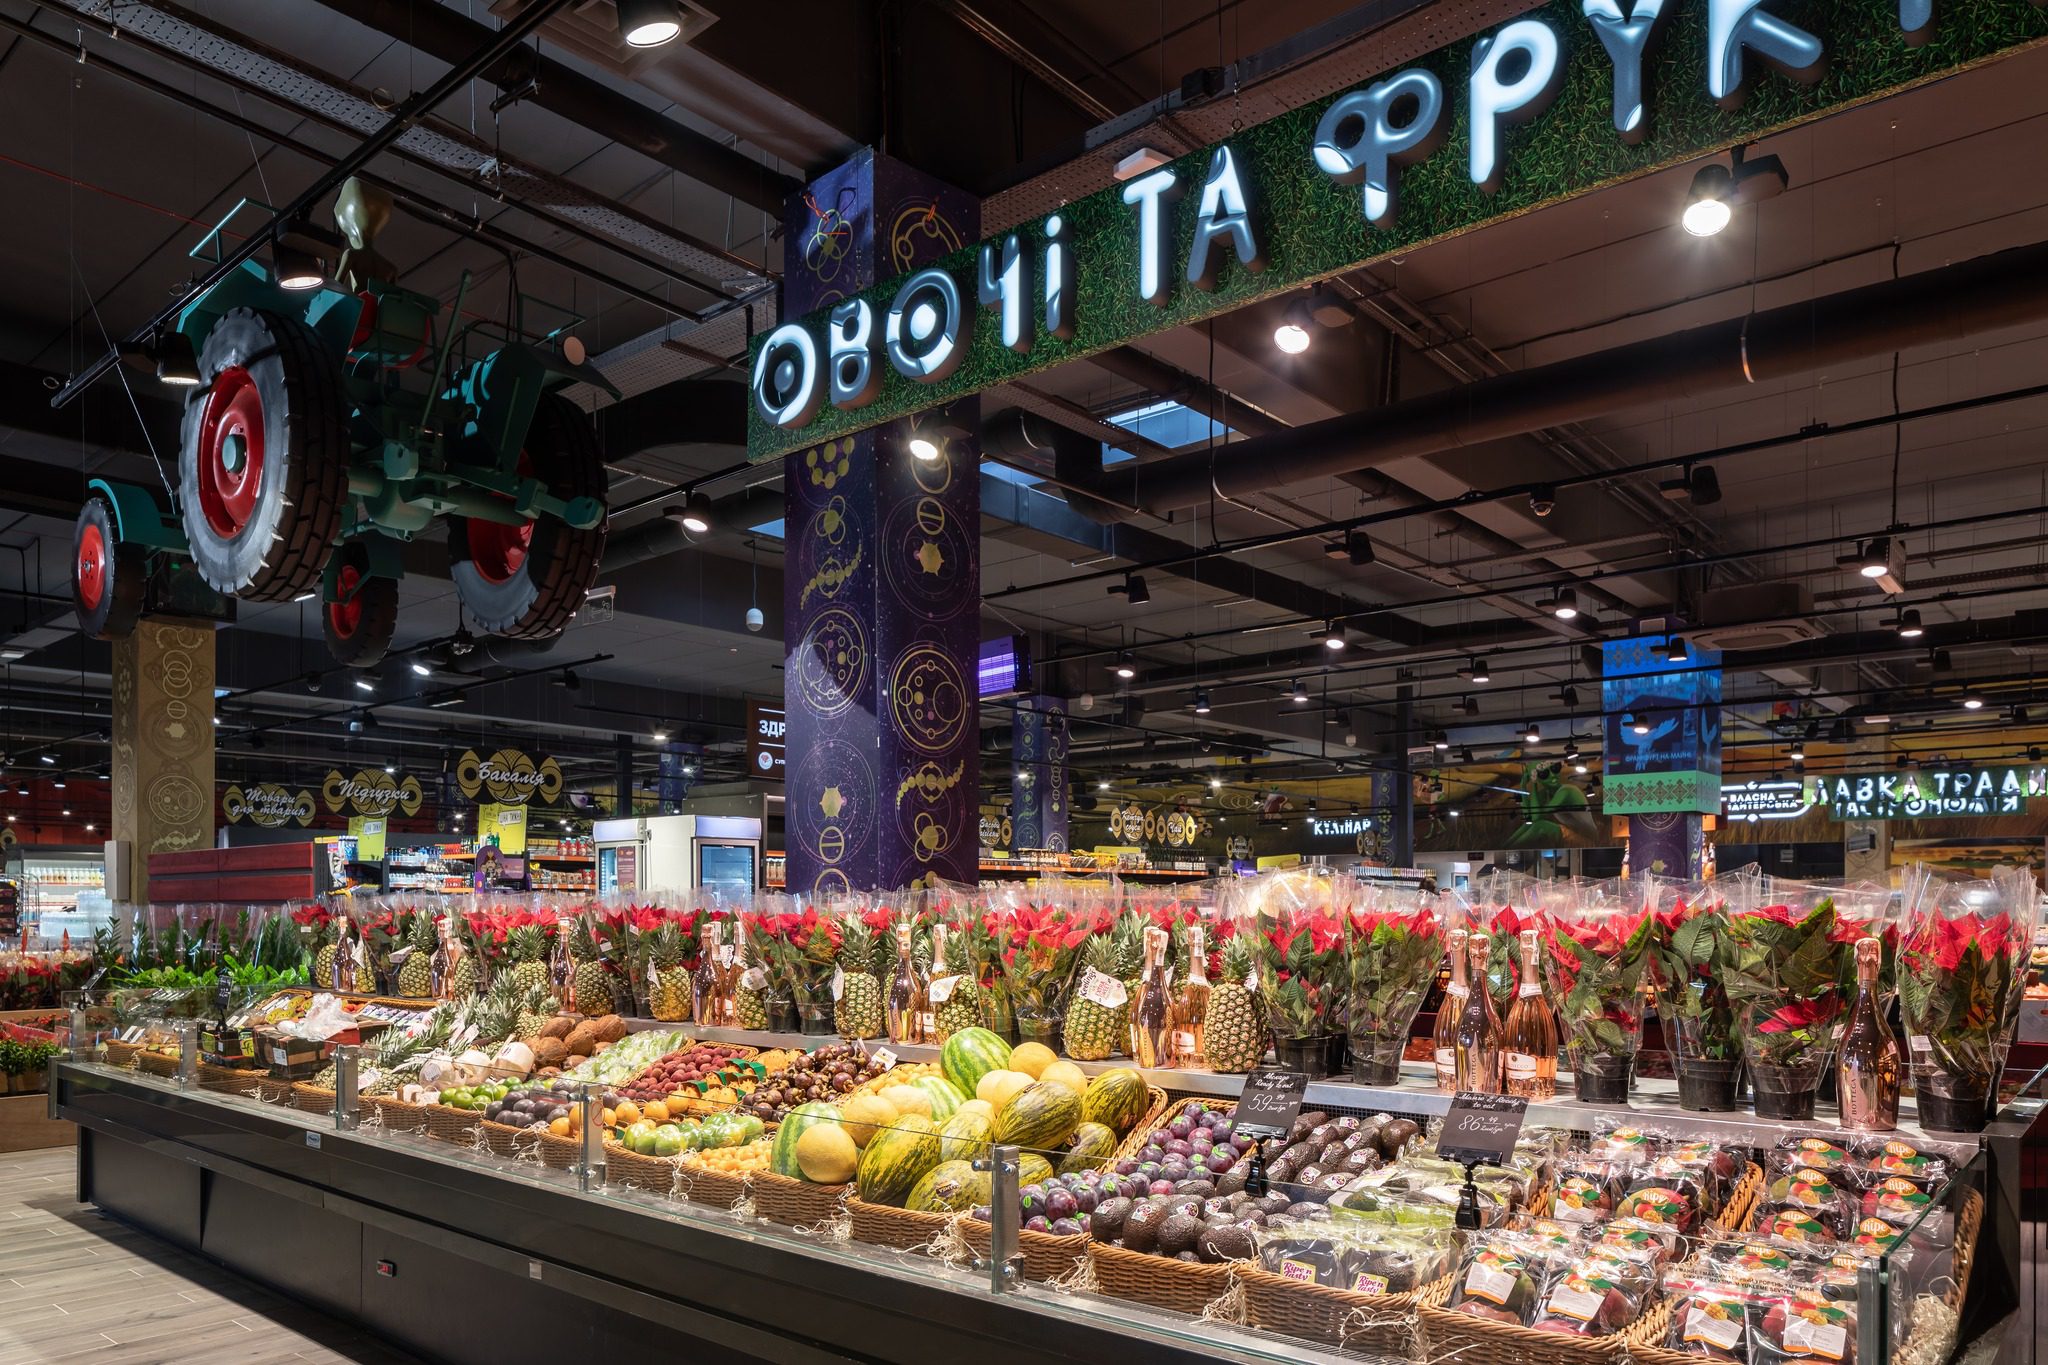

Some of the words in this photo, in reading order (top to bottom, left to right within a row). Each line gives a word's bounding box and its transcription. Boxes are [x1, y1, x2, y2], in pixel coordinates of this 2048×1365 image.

[1123, 145, 1256, 301] ТА
[1313, 0, 1934, 222] ФРУК
[479, 761, 544, 786] Бакалія
[338, 779, 410, 803] Підгузки
[1812, 774, 1921, 804] ЛАВКА
[245, 788, 295, 806] Товари
[1729, 792, 1776, 803] ВЛАСНА
[232, 805, 254, 816] для
[260, 803, 306, 818] тварин
[1255, 1079, 1274, 1090] Ready
[1247, 1093, 1273, 1112] 59
[1458, 1114, 1484, 1131] 86
[1806, 1141, 1827, 1152] Ripe
[1889, 1145, 1910, 1158] Ripe
[1801, 1172, 1822, 1183] Ripe
[1889, 1180, 1911, 1192] Ripe
[1863, 1221, 1886, 1234] Ripe
[1283, 1262, 1304, 1275] Ripe
[1283, 1270, 1308, 1281] Tasty
[1359, 1275, 1377, 1287] Ripe
[1357, 1283, 1379, 1294] Tasty
